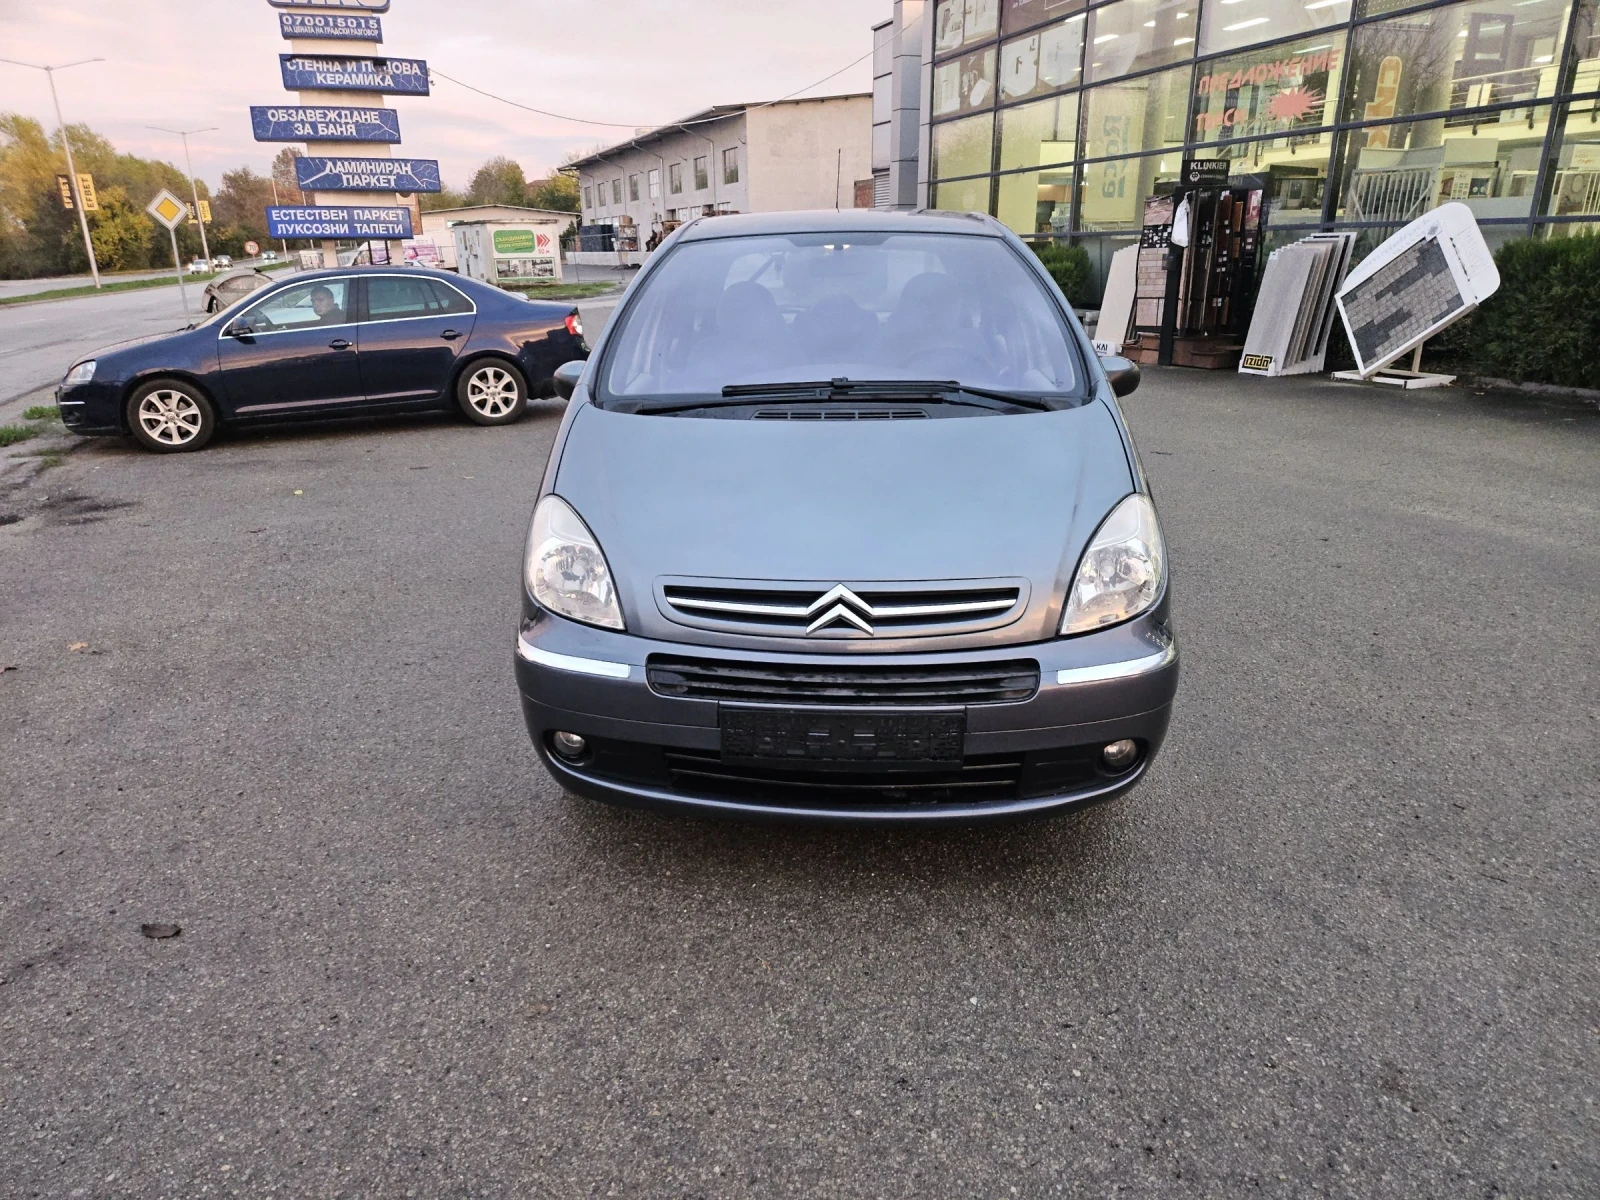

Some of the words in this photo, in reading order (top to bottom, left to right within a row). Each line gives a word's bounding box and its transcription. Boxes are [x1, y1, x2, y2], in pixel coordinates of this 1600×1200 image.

[283, 15, 378, 28] 070015015
[286, 59, 343, 73] СТЕННА
[347, 61, 357, 72] И
[316, 72, 394, 87] КЕРАМИКА
[267, 109, 380, 124] ОБЗАВЕЖДАНЕ
[294, 124, 313, 136] ЗА
[318, 124, 356, 136] БАНЯ
[325, 161, 412, 175] ЛАМИНИРАН
[1190, 161, 1227, 170] KLINKIER
[342, 174, 397, 187] ПАРКЕТ
[271, 209, 348, 221] ЕСТЕСТВЕН
[354, 209, 404, 221] ПАРКЕТ
[277, 223, 349, 235] ЛУКСОЗНИ
[354, 223, 403, 234] ТАПЕТИ
[1096, 343, 1108, 351] KAI
